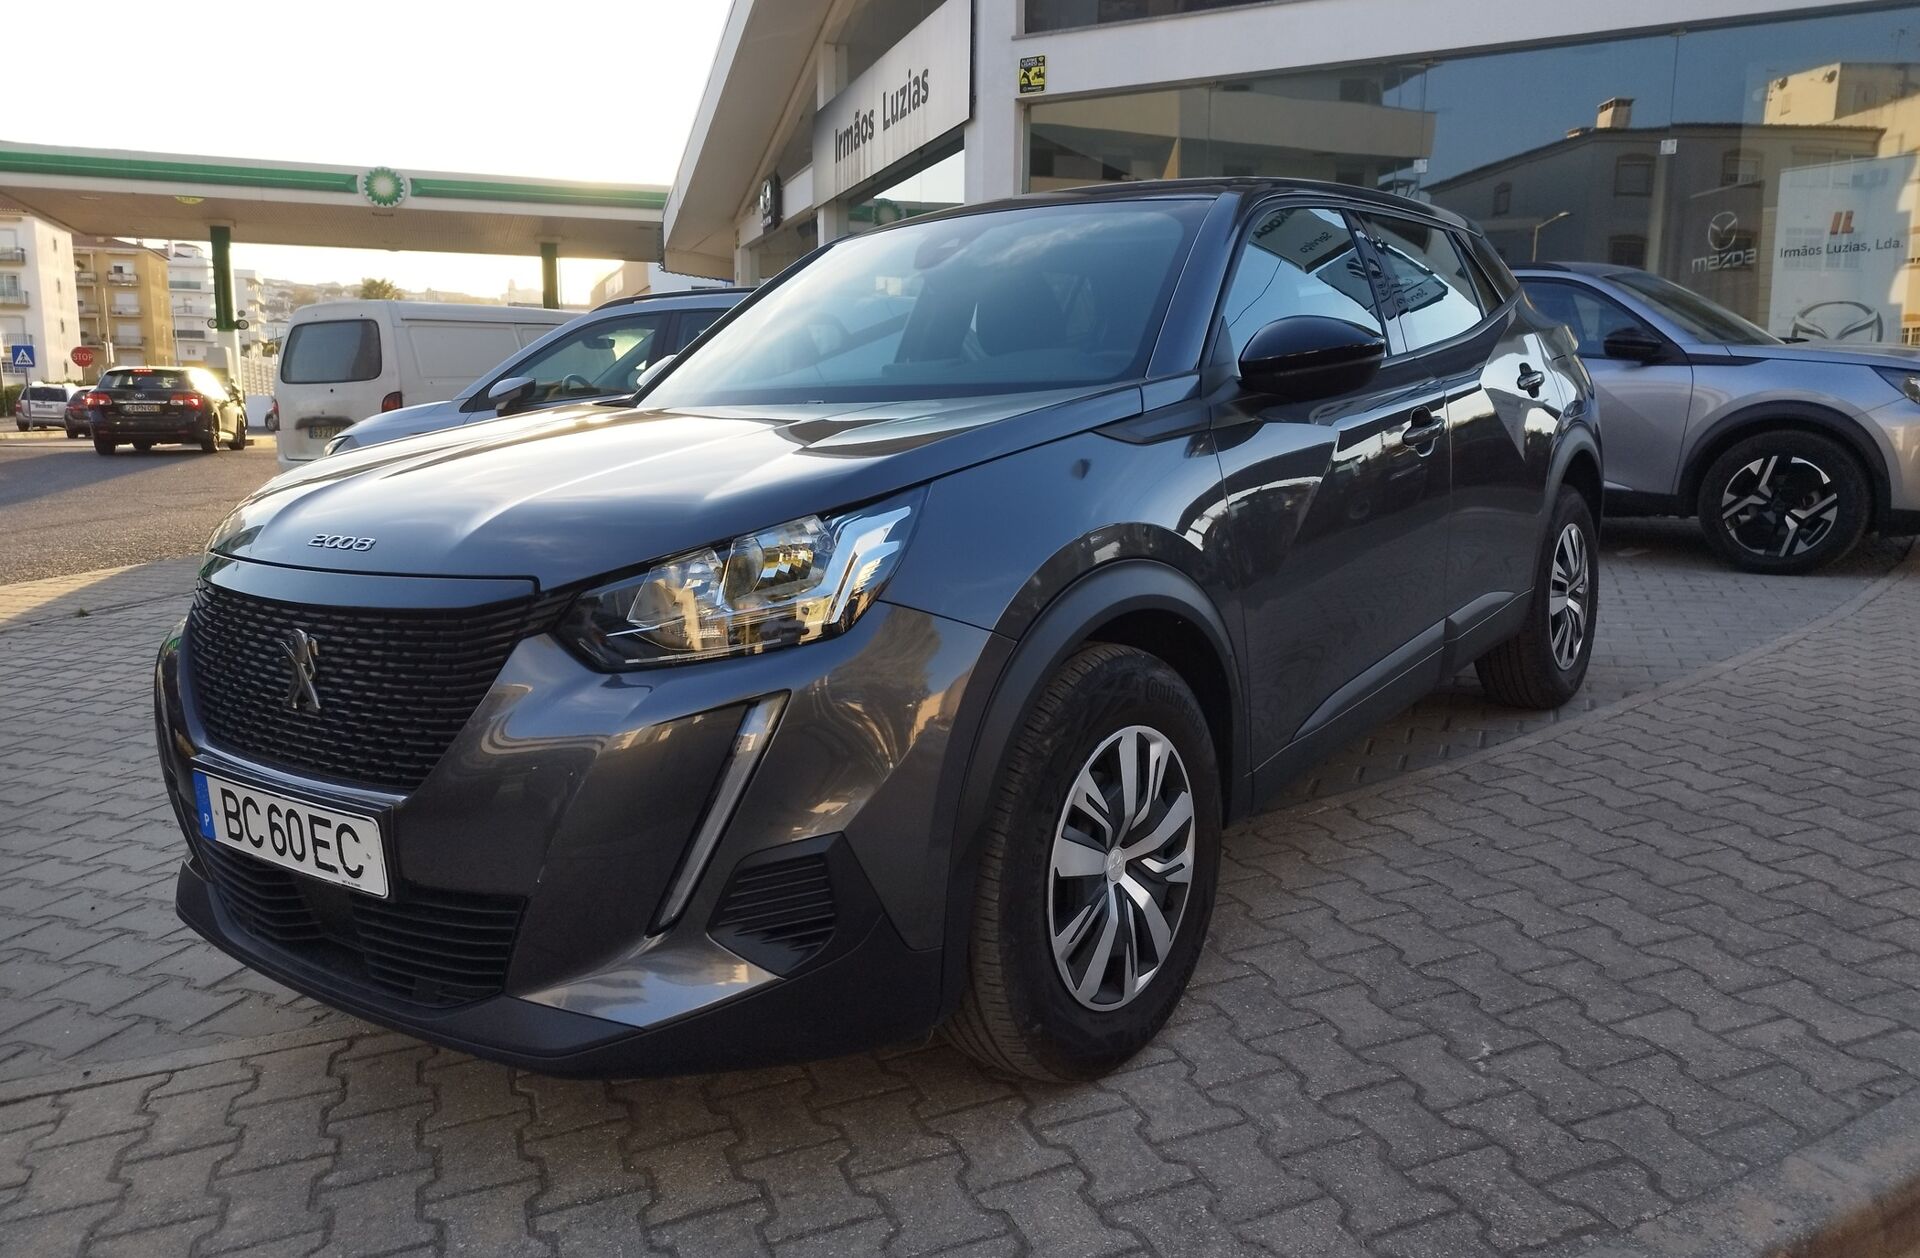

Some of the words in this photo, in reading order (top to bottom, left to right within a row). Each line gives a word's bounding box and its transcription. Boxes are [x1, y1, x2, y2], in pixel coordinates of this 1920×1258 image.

[835, 109, 875, 164] Irmãos
[883, 68, 929, 132] Luzias
[1780, 245, 1822, 258] Irmãos
[1826, 241, 1871, 254] Luzias,
[1875, 237, 1904, 251] Lda.
[72, 353, 93, 361] STOP
[307, 533, 377, 552] 2008
